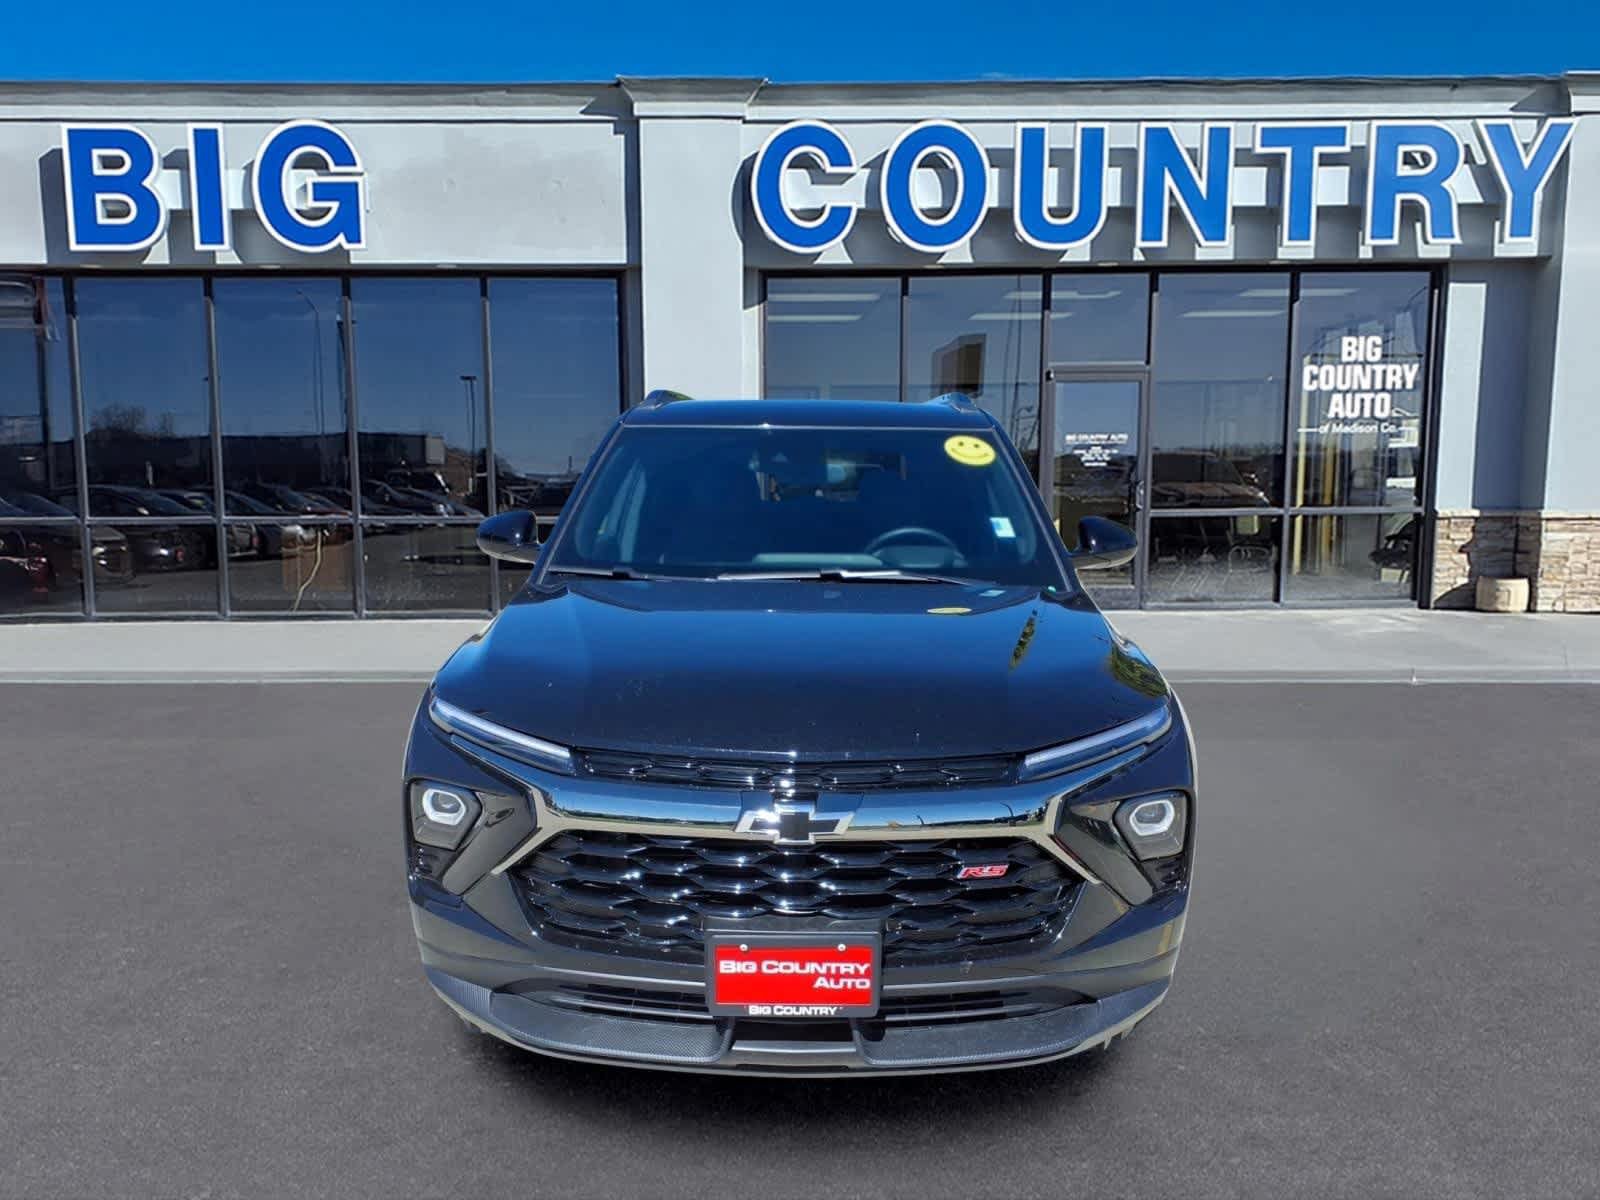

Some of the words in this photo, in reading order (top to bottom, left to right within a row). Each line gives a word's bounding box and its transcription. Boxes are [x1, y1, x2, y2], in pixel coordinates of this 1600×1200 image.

[61, 119, 367, 252] BIG
[752, 119, 1576, 253] COUNTRY
[1341, 335, 1382, 362] BIG
[1302, 363, 1419, 391] COUNTRY
[1327, 392, 1391, 418] AUTO
[1319, 422, 1331, 434] of
[1331, 422, 1378, 433] Madison
[957, 864, 1009, 879] RS
[718, 960, 757, 974] BIG
[761, 960, 870, 975] COUNTRY
[812, 977, 871, 989] AUTO
[773, 1005, 837, 1016] COUNTRY
